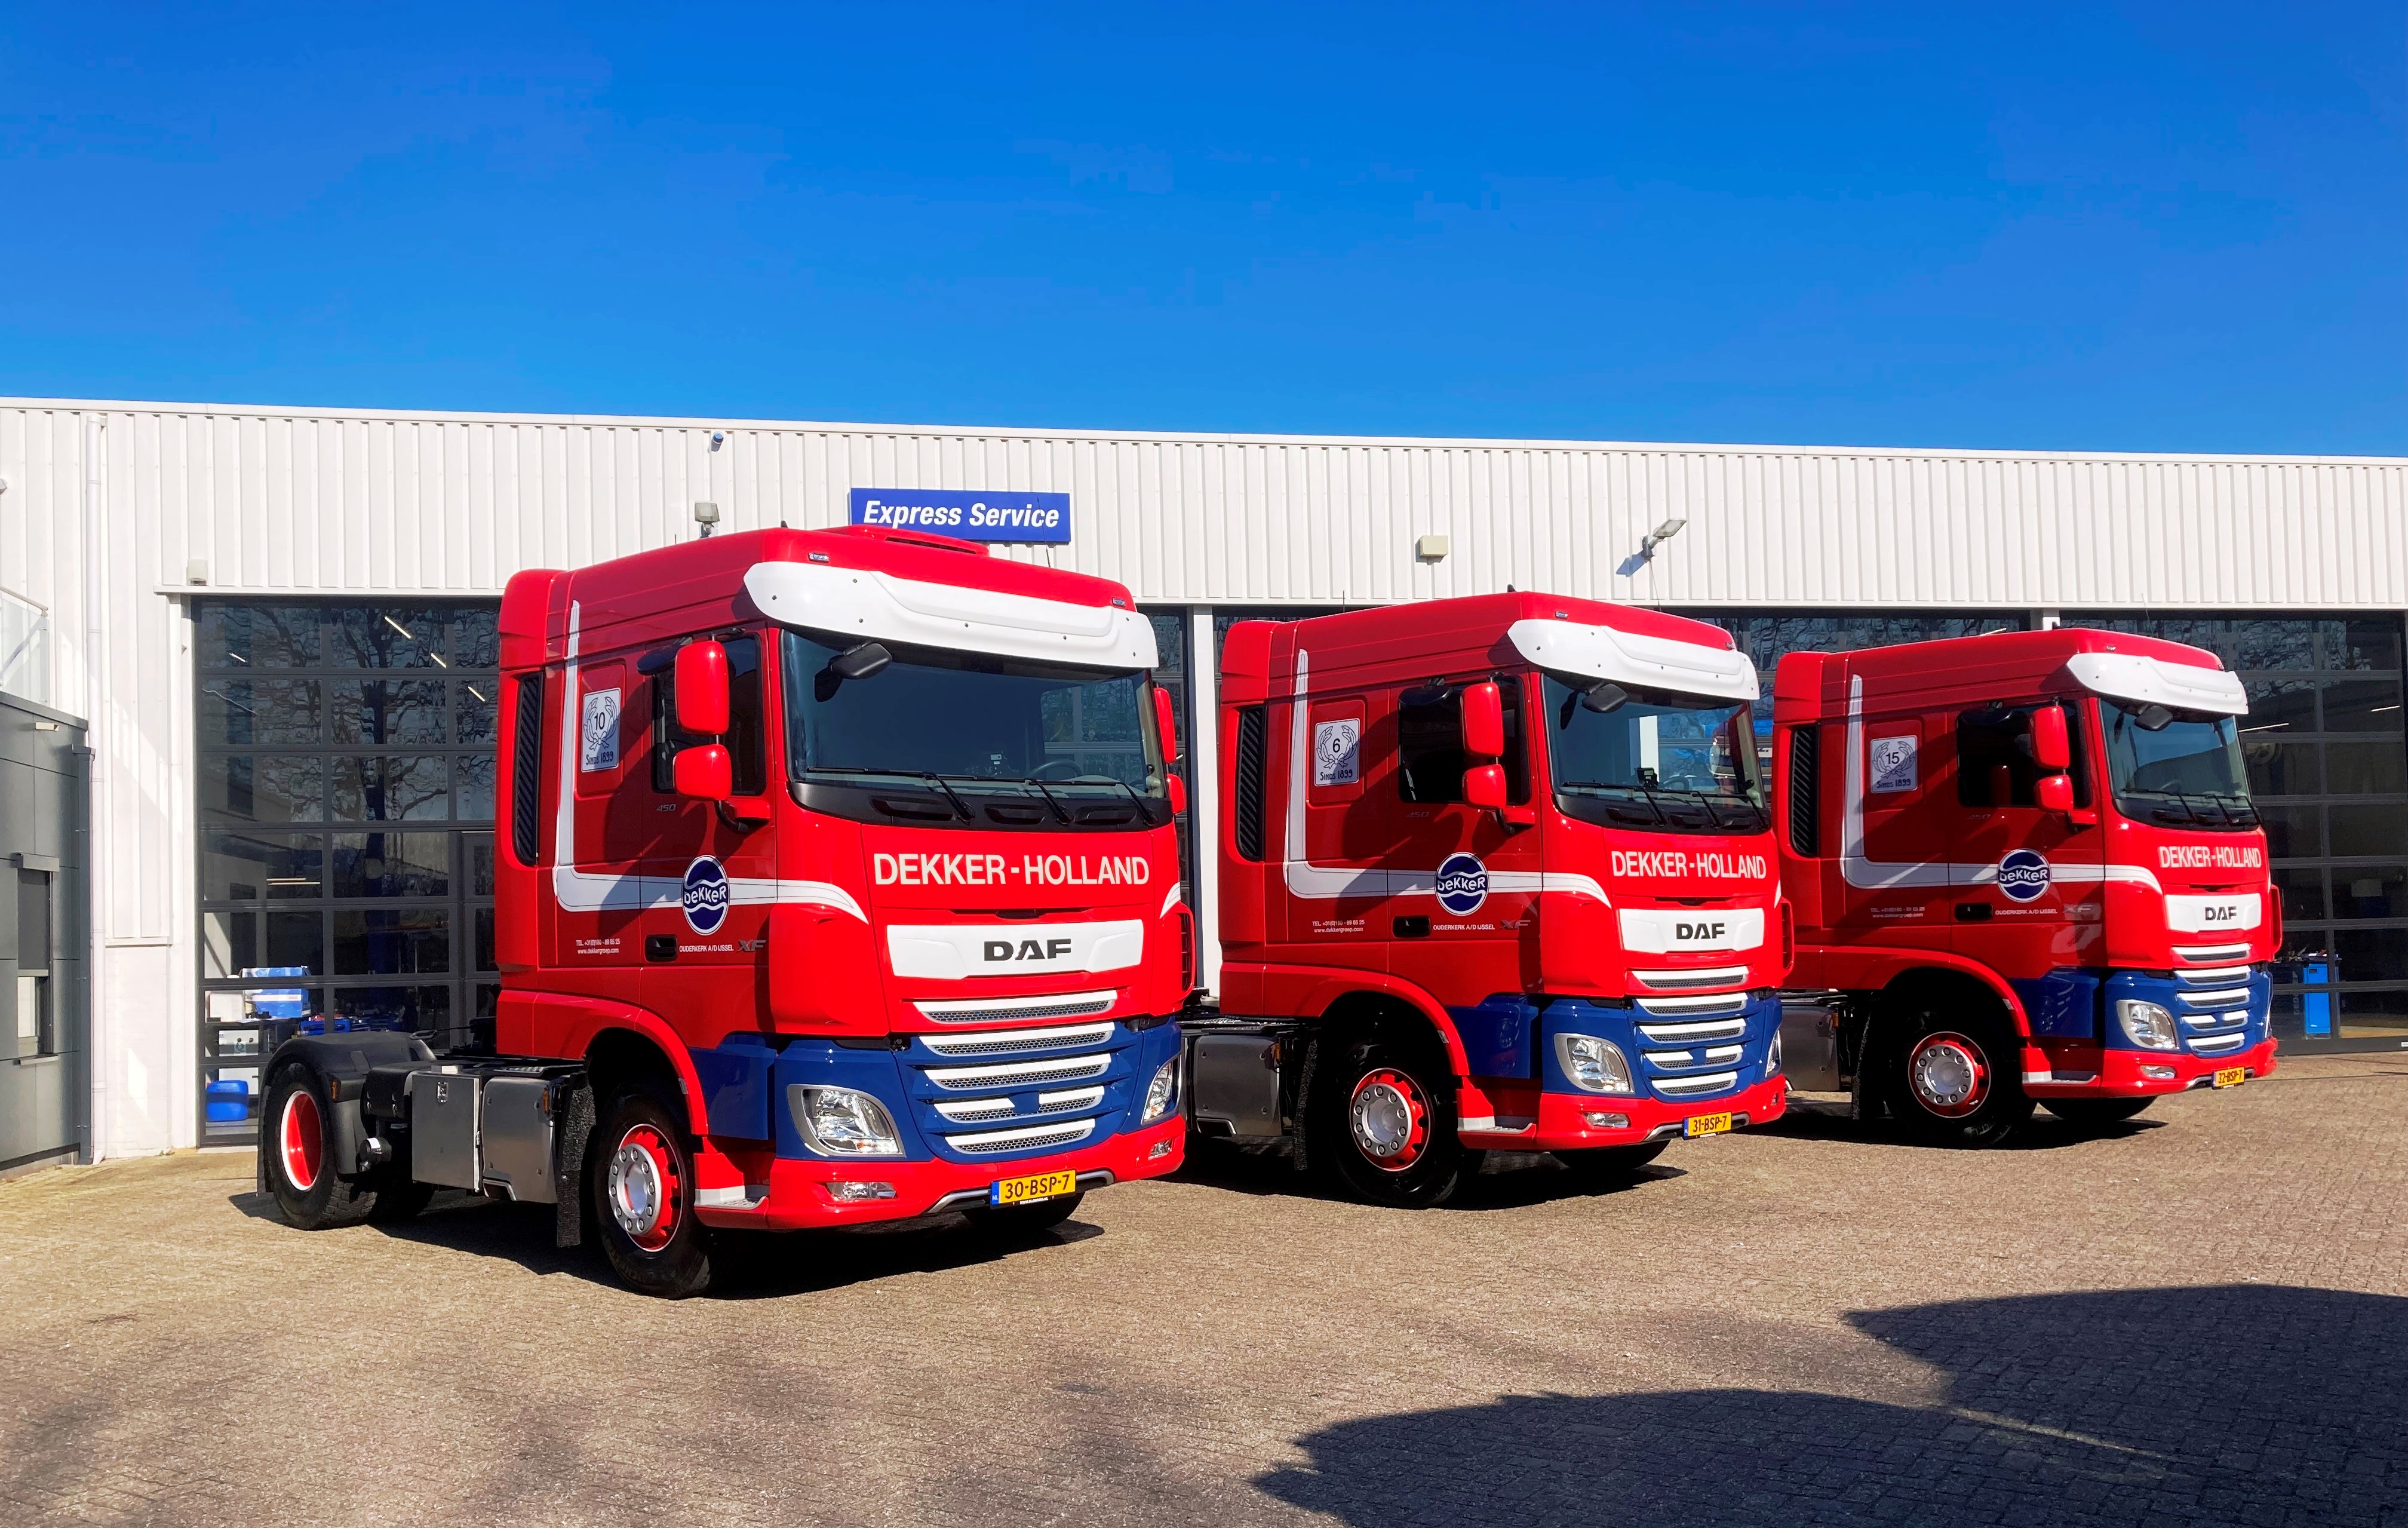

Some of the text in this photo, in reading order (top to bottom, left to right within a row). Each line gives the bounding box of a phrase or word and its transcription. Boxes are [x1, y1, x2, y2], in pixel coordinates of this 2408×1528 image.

[864, 500, 1059, 529] Express Service
[594, 711, 606, 730] 10
[1332, 738, 1341, 753] 6
[600, 750, 613, 763] 1899
[1885, 751, 1900, 765] 15
[1338, 769, 1353, 779] 1899
[1896, 778, 1911, 787] 1899
[656, 803, 677, 812] 450
[2205, 906, 2237, 921] DAF
[1500, 919, 1531, 930] XF
[1676, 922, 1725, 940] DAF
[738, 940, 767, 952] XF
[984, 938, 1071, 961] DAF
[2218, 1069, 2243, 1084] 32-BSP-7
[1693, 1115, 1727, 1133] 31-BSP-7
[1005, 1174, 1070, 1199] 30-BSP-7
